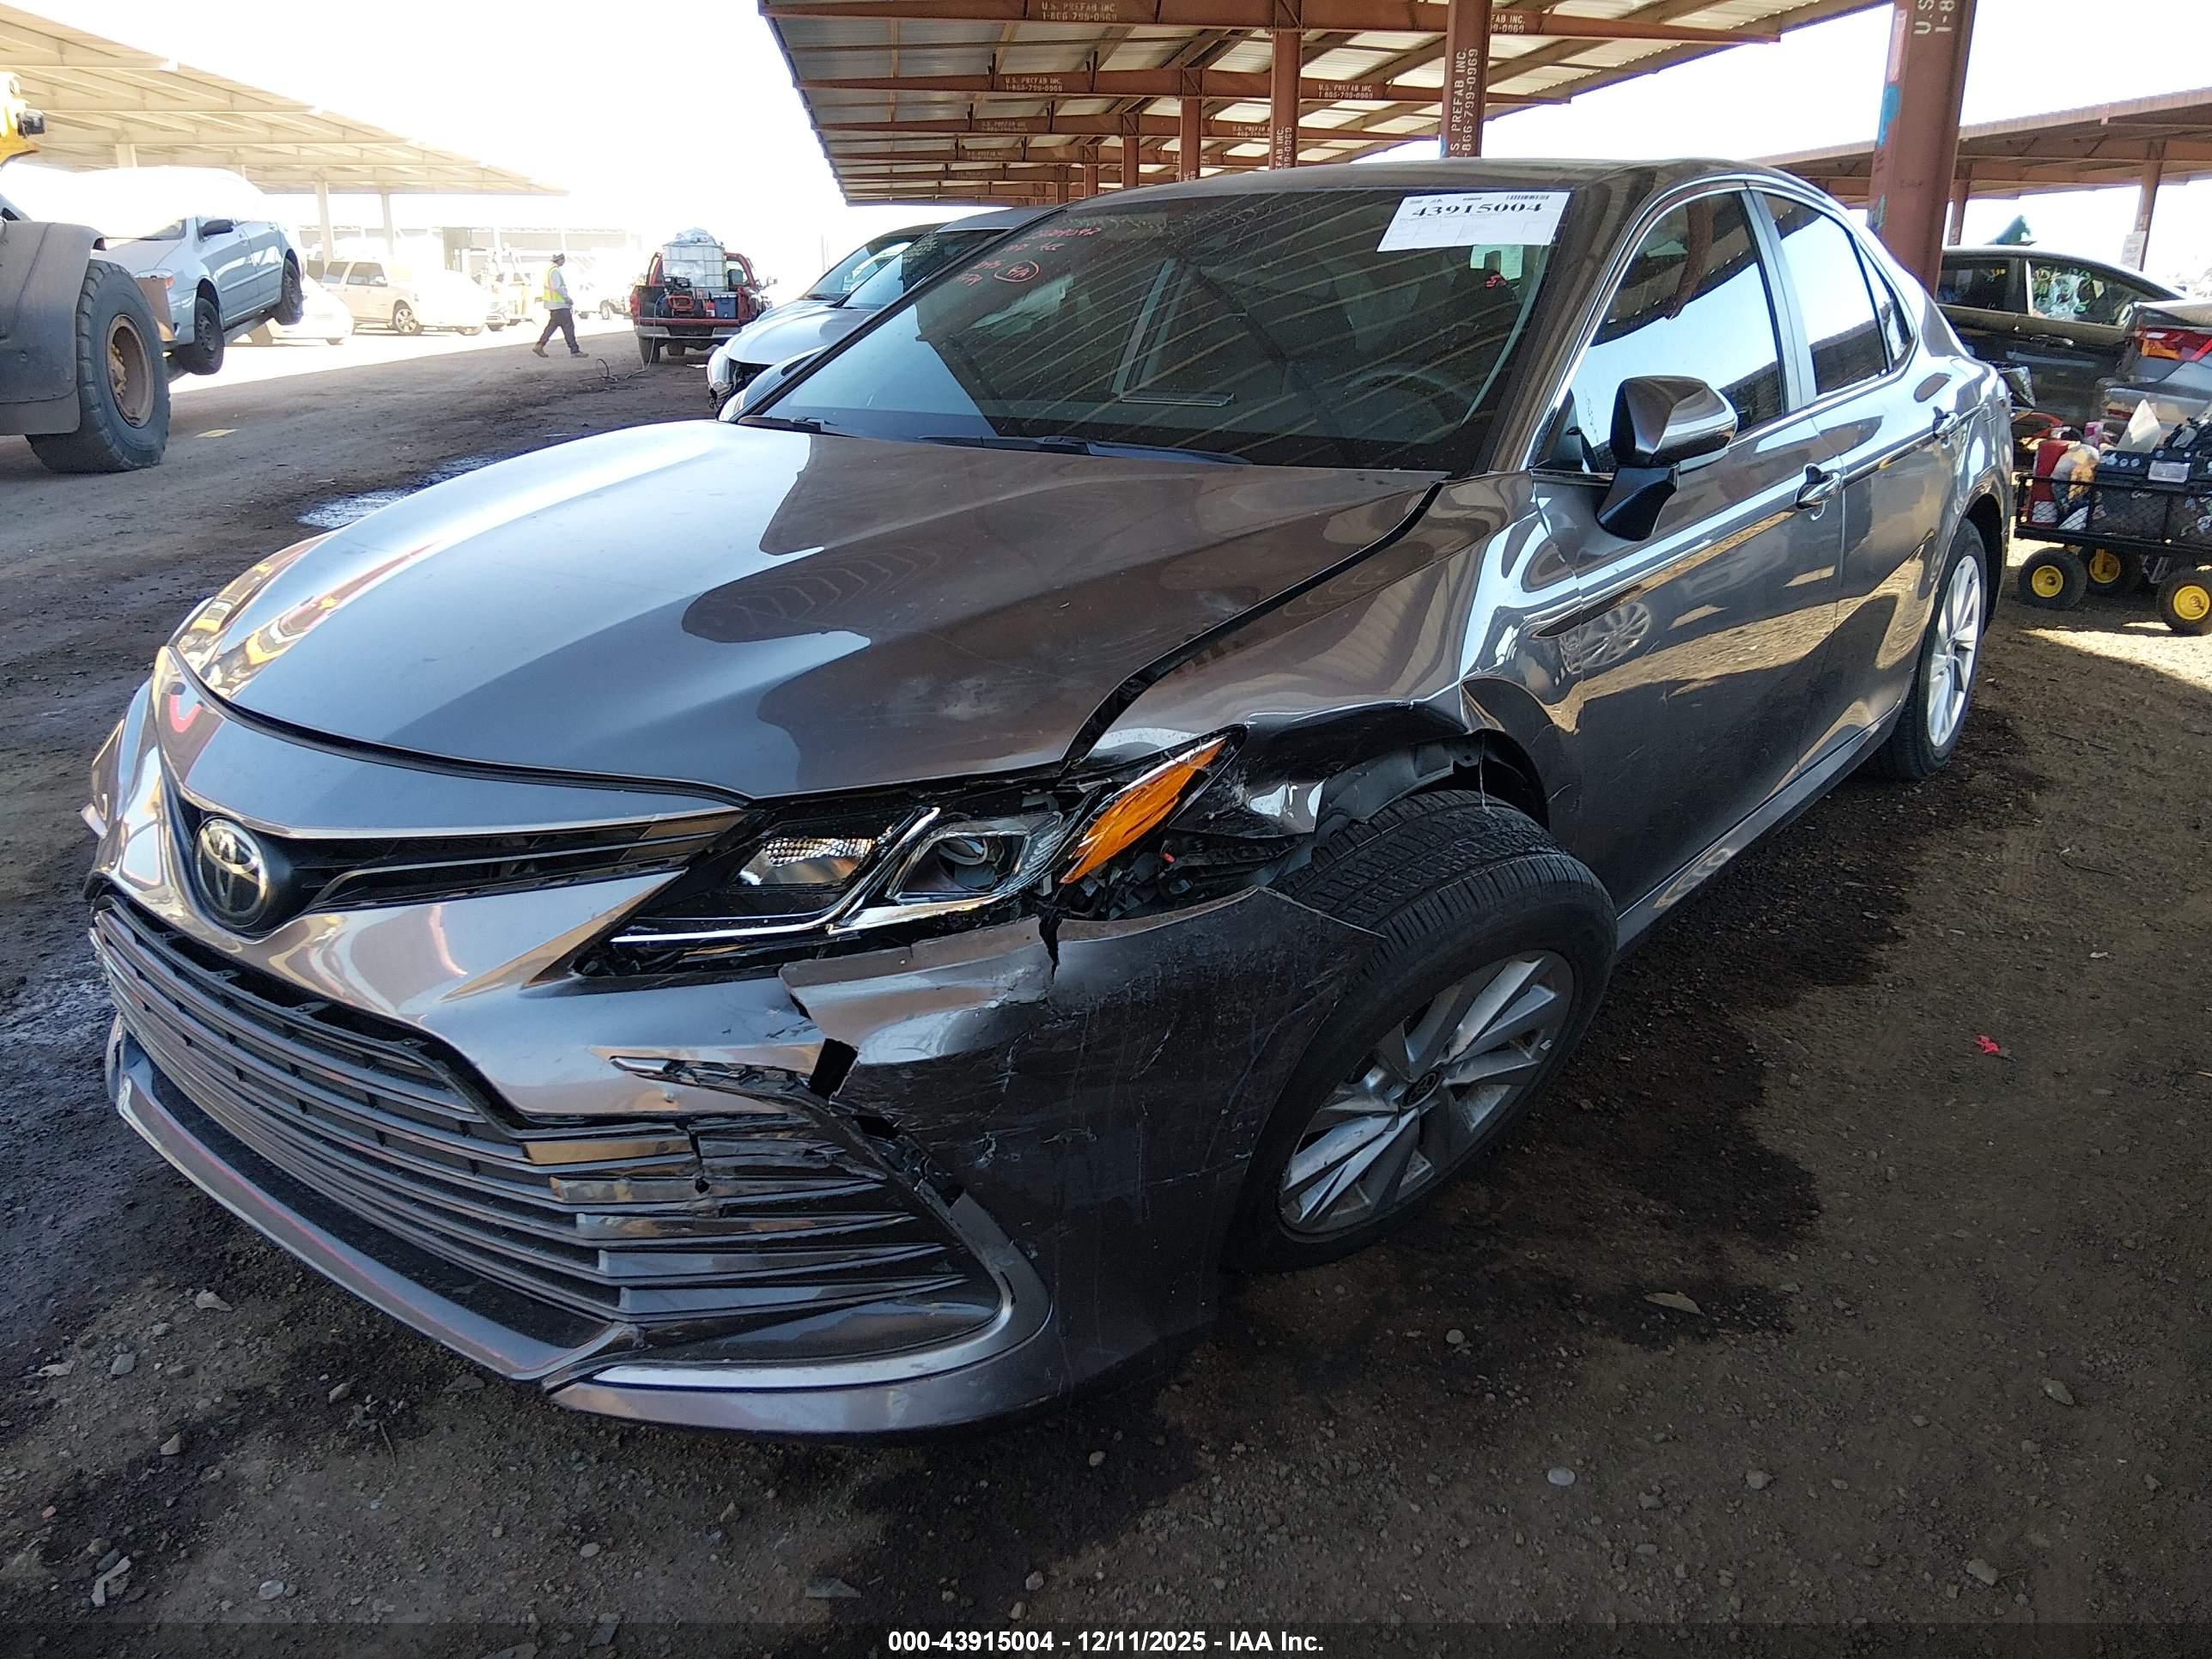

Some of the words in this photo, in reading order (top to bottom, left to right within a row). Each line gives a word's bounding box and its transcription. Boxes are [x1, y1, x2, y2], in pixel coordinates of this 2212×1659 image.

[1063, 3, 1097, 12] PREFAB
[1455, 47, 1468, 73] INC.
[1451, 80, 1465, 132] PREFAB
[1462, 48, 1478, 158] -866-799-0969
[1276, 126, 1285, 144] INC.
[1412, 202, 1543, 217] 43915004
